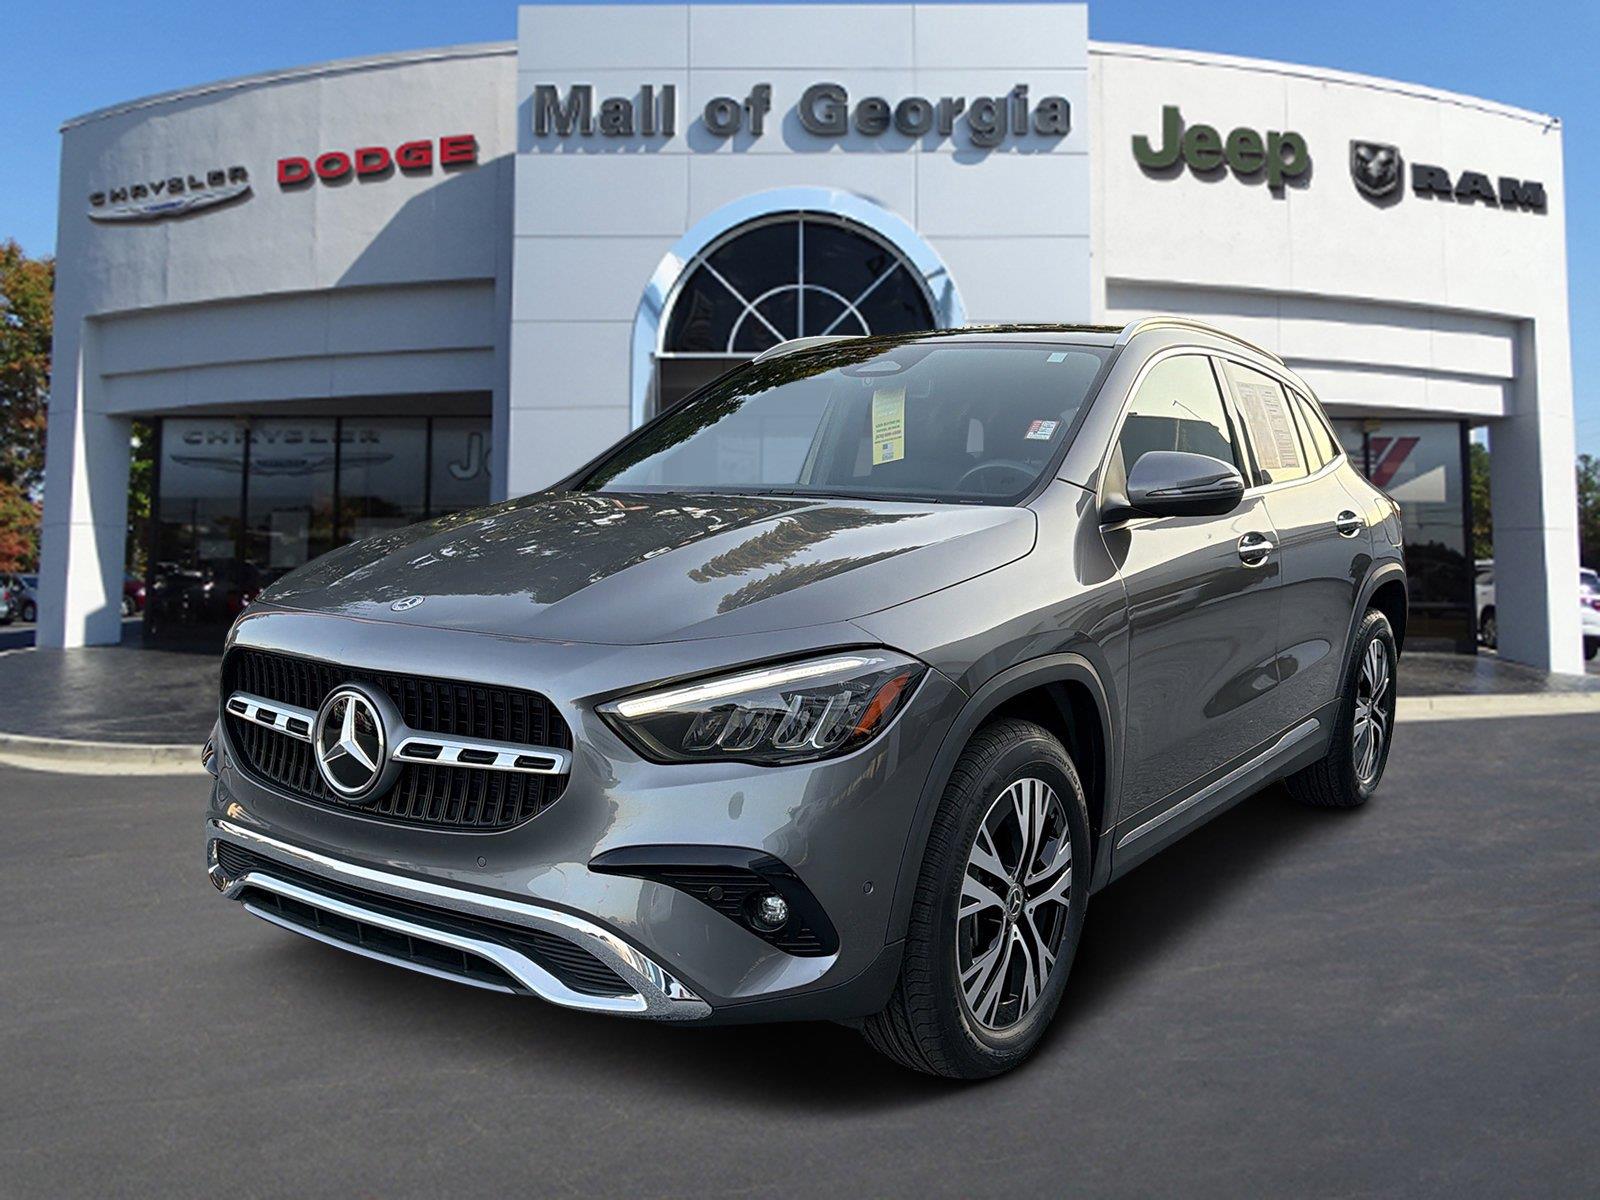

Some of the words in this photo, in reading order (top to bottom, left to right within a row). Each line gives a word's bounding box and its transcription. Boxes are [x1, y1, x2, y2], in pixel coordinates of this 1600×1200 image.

[531, 84, 678, 138] Mall
[702, 84, 773, 139] of
[798, 83, 1073, 147] Georgia
[277, 134, 477, 189] DODGE
[1131, 105, 1309, 191] Jeep
[89, 165, 249, 207] CHRYSLER
[1411, 163, 1548, 214] RAM
[183, 429, 381, 444] CHRYSLER
[448, 431, 492, 480] J
